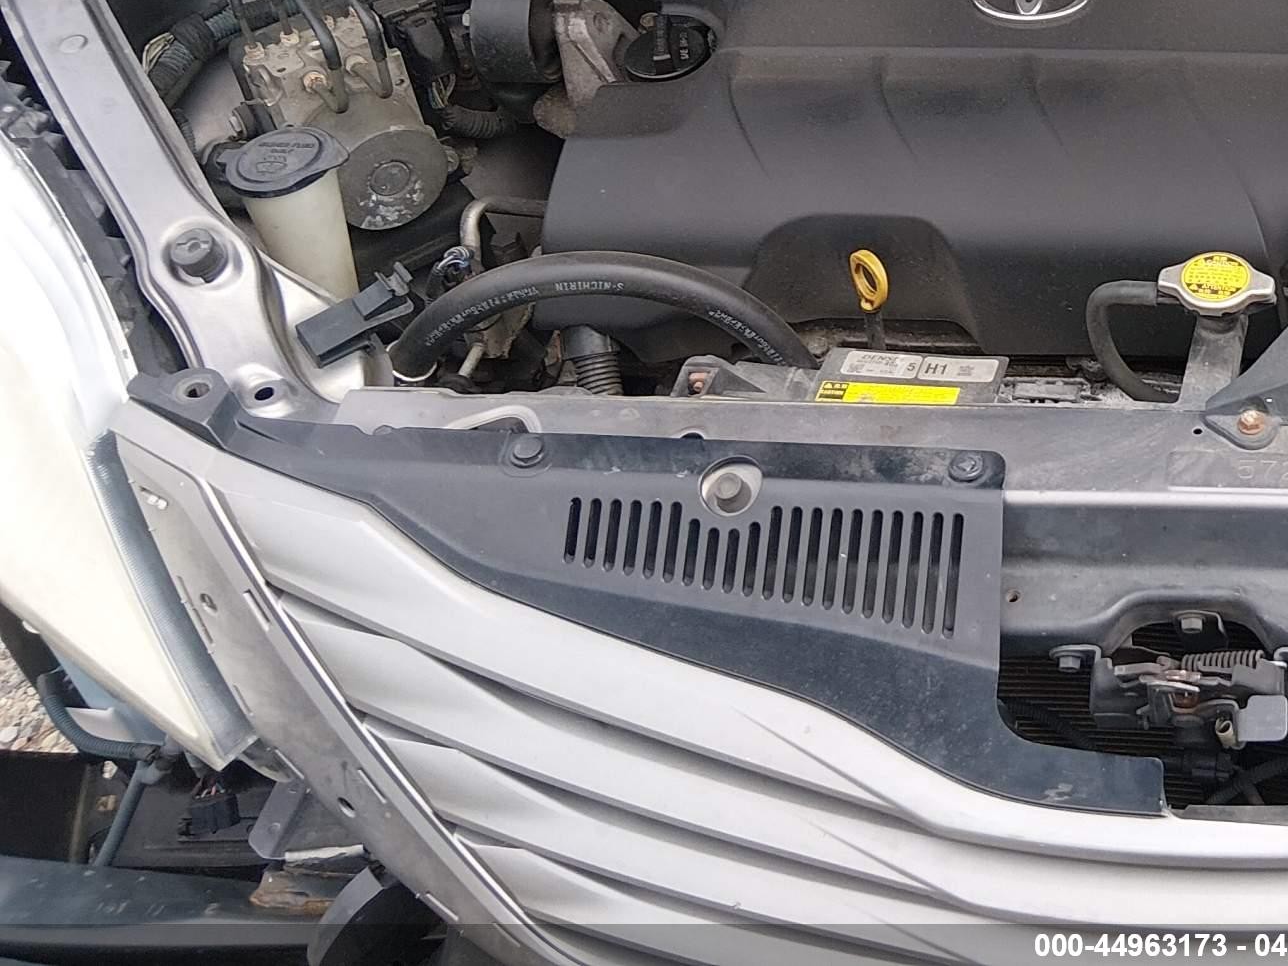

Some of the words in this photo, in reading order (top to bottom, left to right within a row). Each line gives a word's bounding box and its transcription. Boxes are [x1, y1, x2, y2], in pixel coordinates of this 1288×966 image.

[554, 281, 625, 292] S-NICHIRIN
[906, 362, 917, 372] 5
[924, 362, 949, 375] H1
